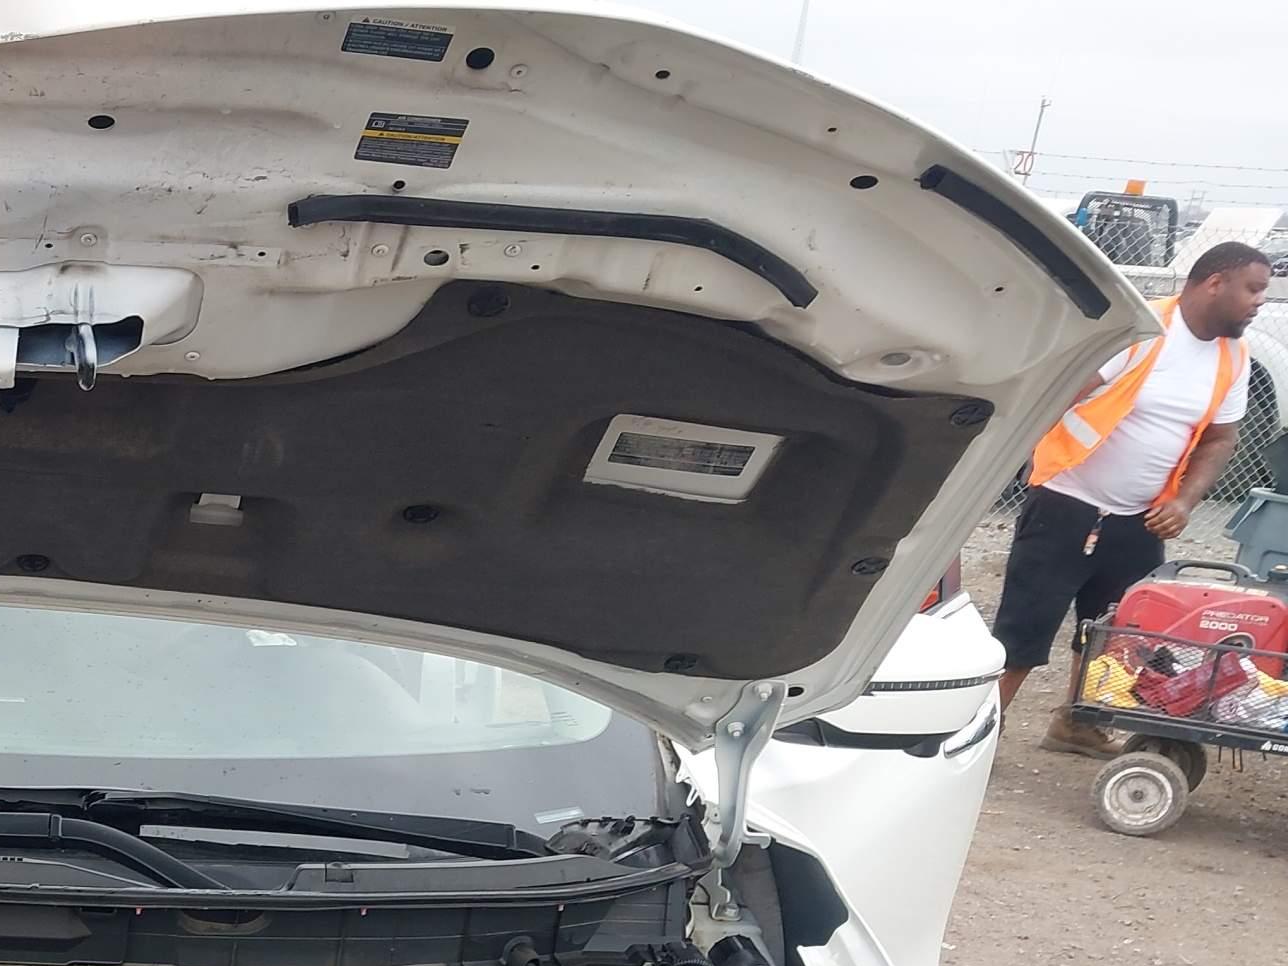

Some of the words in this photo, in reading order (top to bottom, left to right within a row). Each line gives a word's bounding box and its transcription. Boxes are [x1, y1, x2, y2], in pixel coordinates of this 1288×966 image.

[373, 18, 404, 27] CAUTION
[410, 23, 448, 32] ATTENTION
[1202, 610, 1270, 623] PREDATOR
[1199, 620, 1239, 632] 2000
